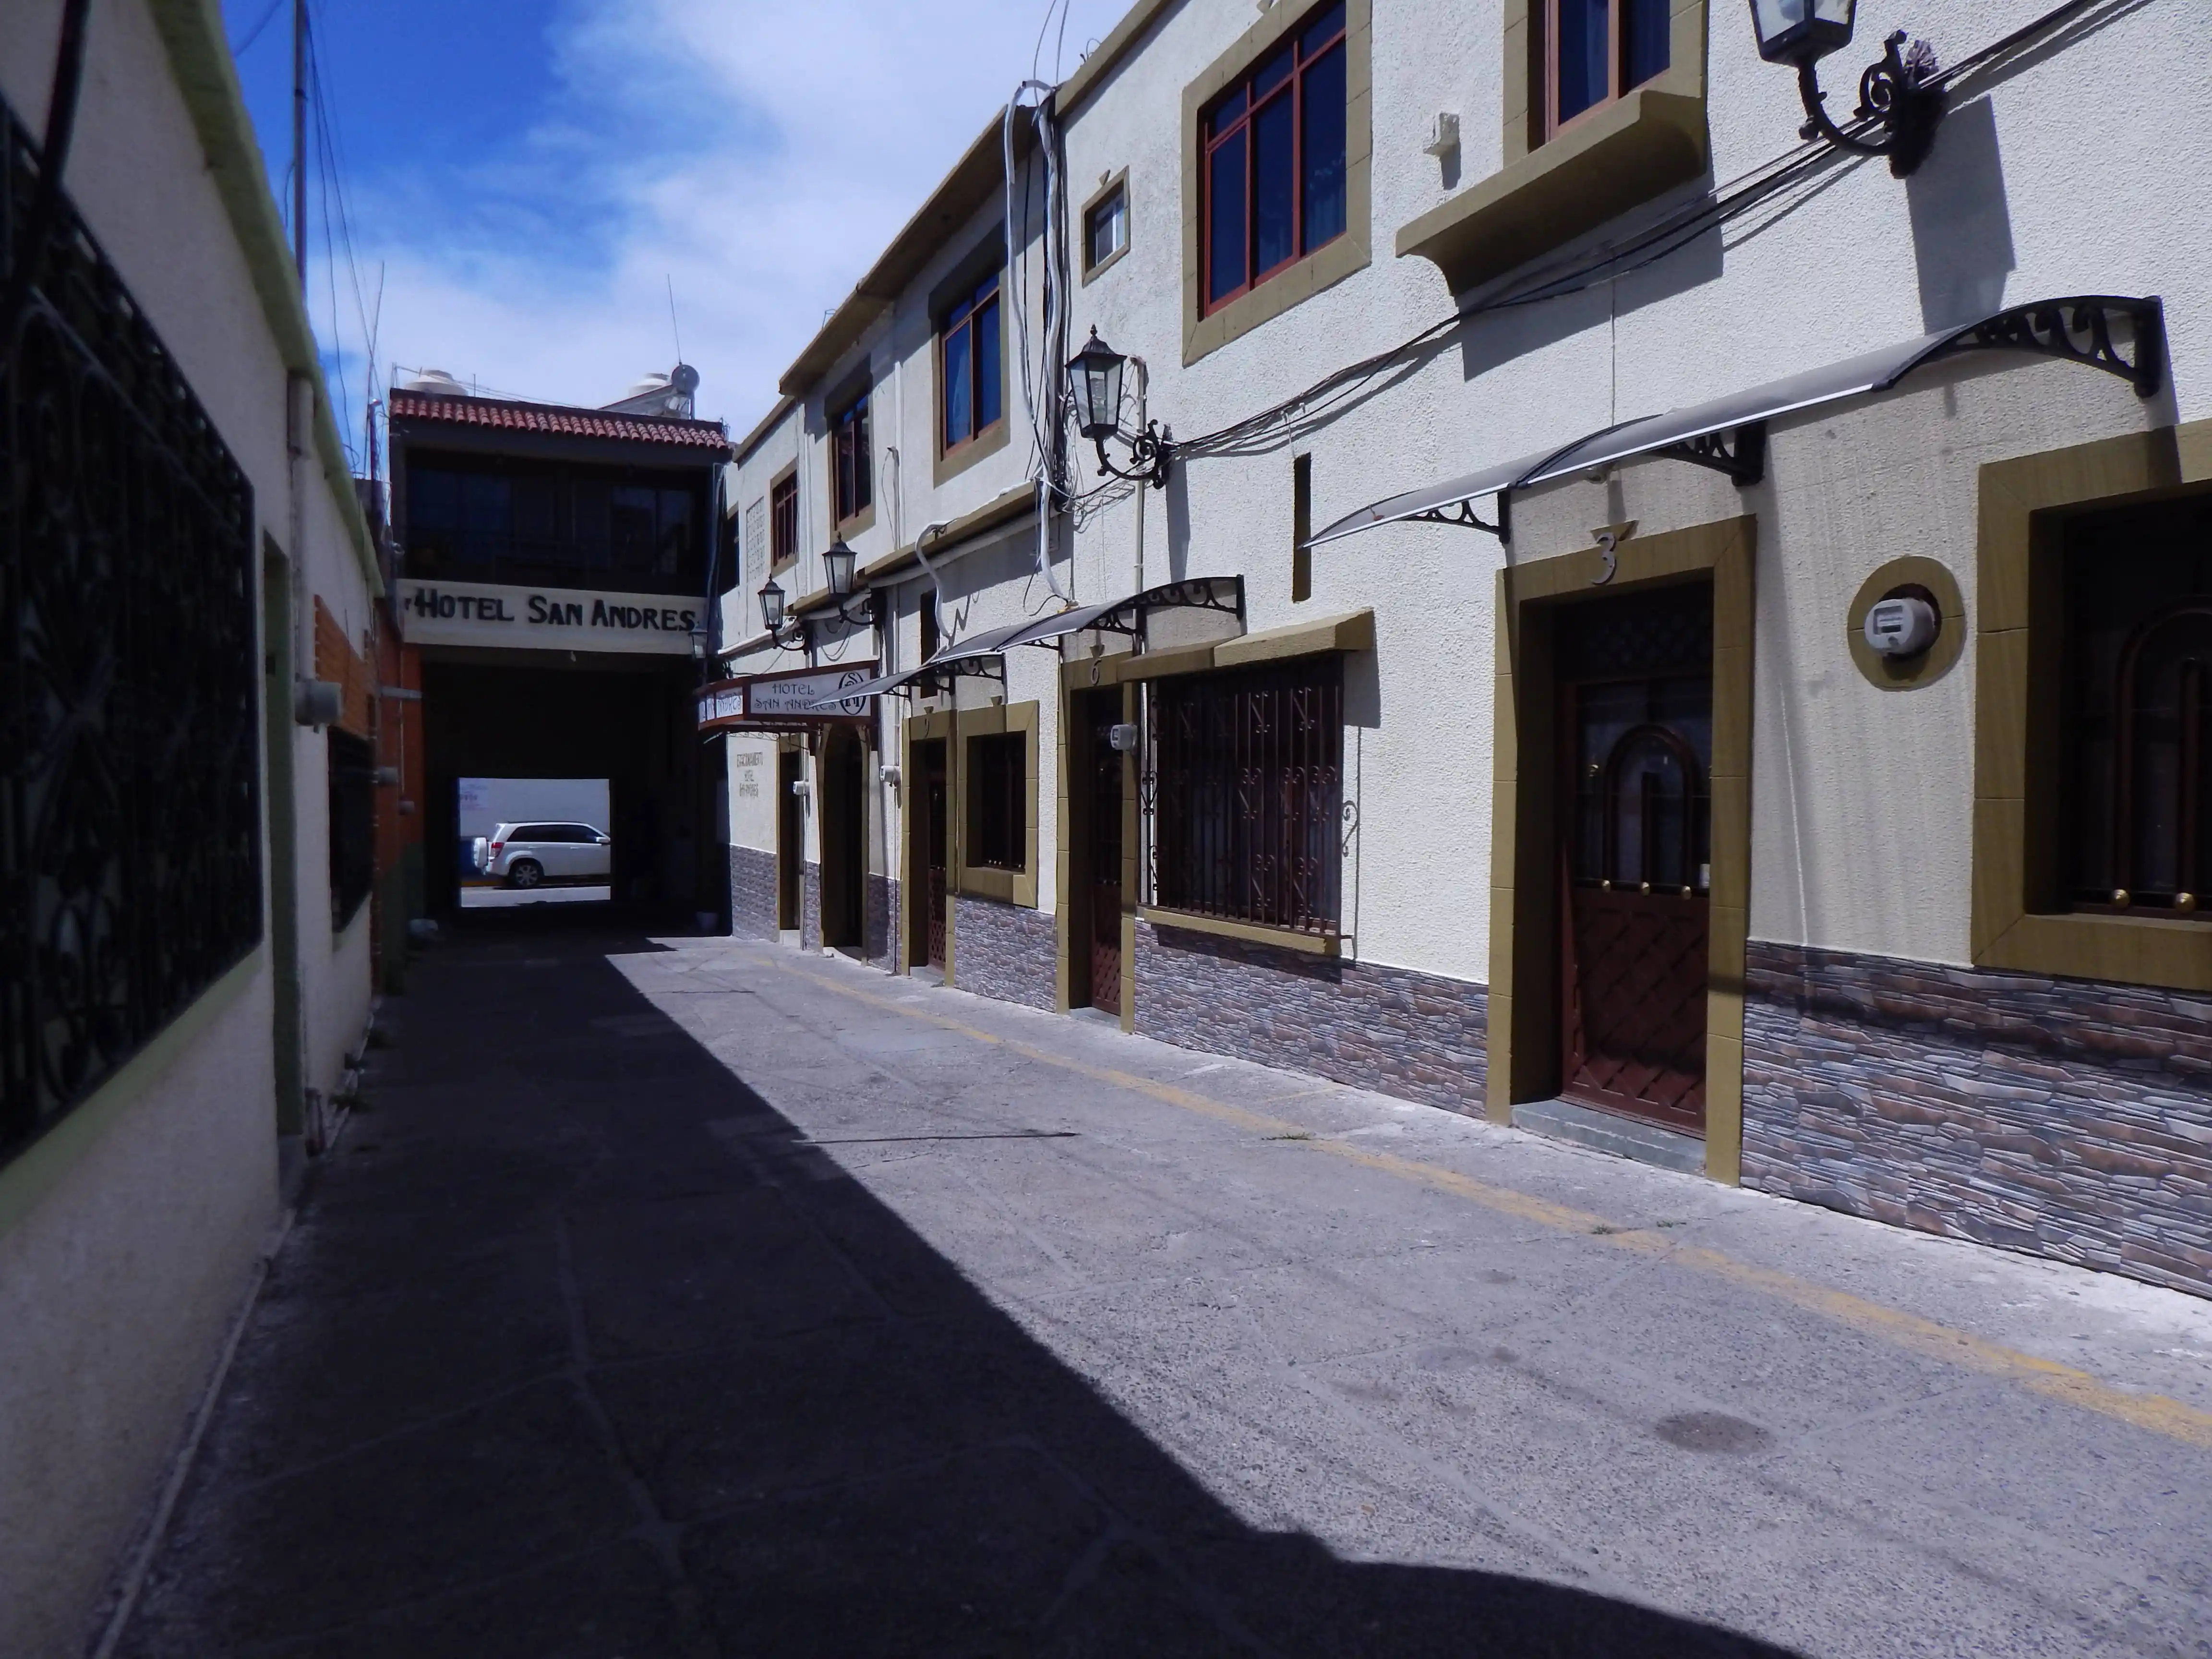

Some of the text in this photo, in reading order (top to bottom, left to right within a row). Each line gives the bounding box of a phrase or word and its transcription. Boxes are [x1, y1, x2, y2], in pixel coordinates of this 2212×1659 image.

[1591, 532, 1616, 585] 3
[414, 588, 696, 631] HOTEL SAN ANDRES
[1091, 659, 1102, 686] 6
[772, 683, 815, 695] HOTEL
[754, 698, 780, 711] SAN
